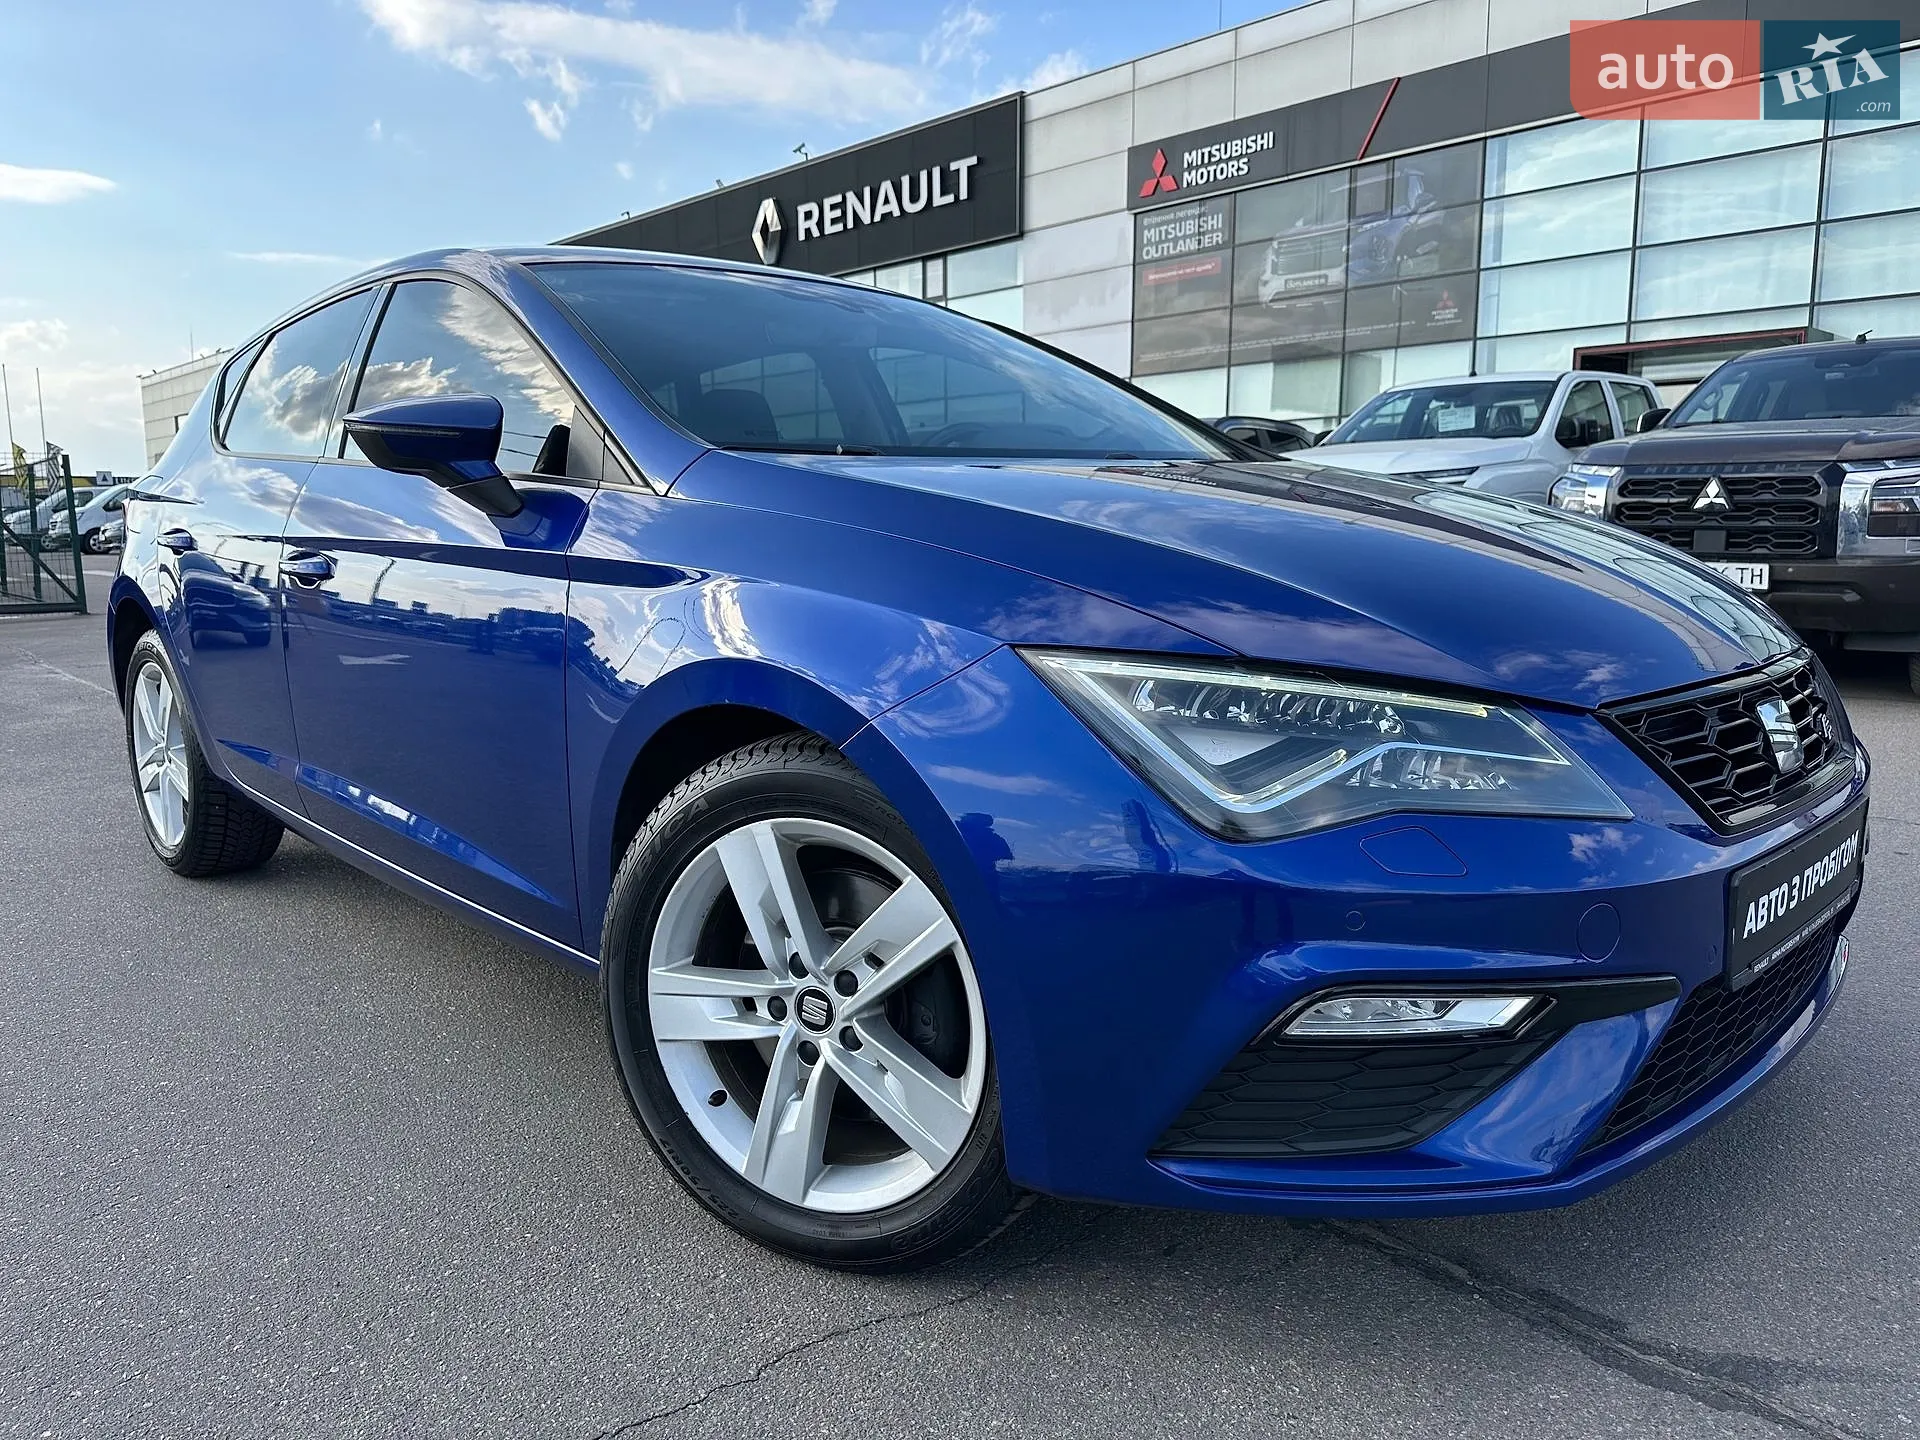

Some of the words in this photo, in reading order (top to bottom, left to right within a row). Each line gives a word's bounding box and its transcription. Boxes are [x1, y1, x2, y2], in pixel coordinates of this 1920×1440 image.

[1183, 131, 1274, 168] MITSUBISHI
[1182, 157, 1249, 188] MOTORS
[797, 155, 978, 241] RENAULT
[1143, 213, 1223, 244] MITSUBISHI
[1142, 232, 1223, 260] OUTLANDER
[1735, 567, 1763, 585] TH
[1742, 883, 1788, 939] АВТО
[1789, 875, 1800, 910] З
[1801, 829, 1859, 902] ПРОБІГОМ
